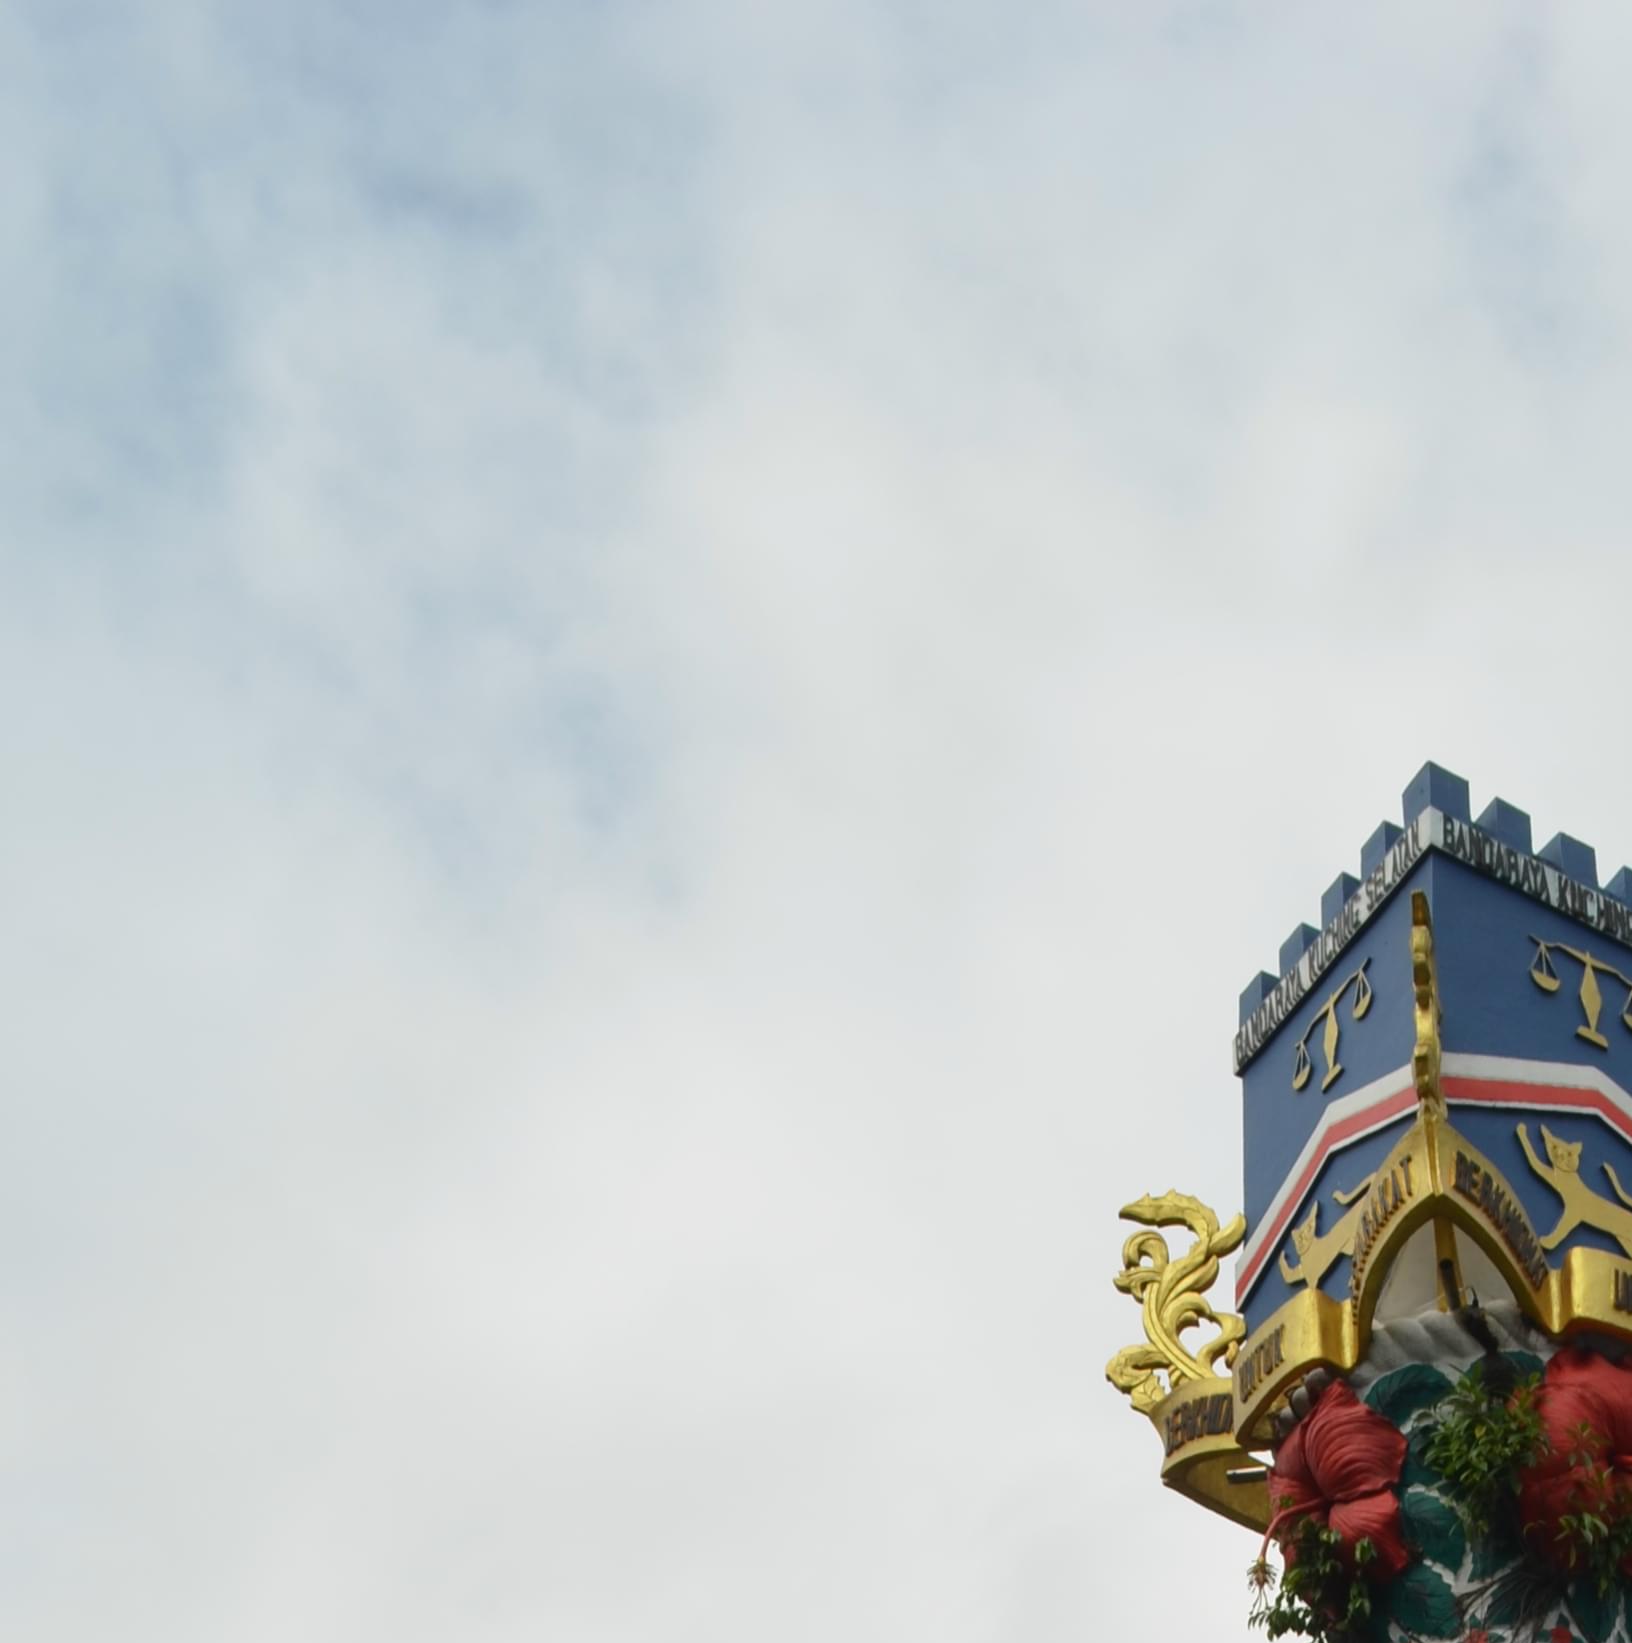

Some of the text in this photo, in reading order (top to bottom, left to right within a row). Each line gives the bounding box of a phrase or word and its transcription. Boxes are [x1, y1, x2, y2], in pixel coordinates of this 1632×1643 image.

[1442, 815, 1551, 901] BANDARAYA
[1235, 818, 1423, 1067] BANDARAYA KUCHING SELATAN
